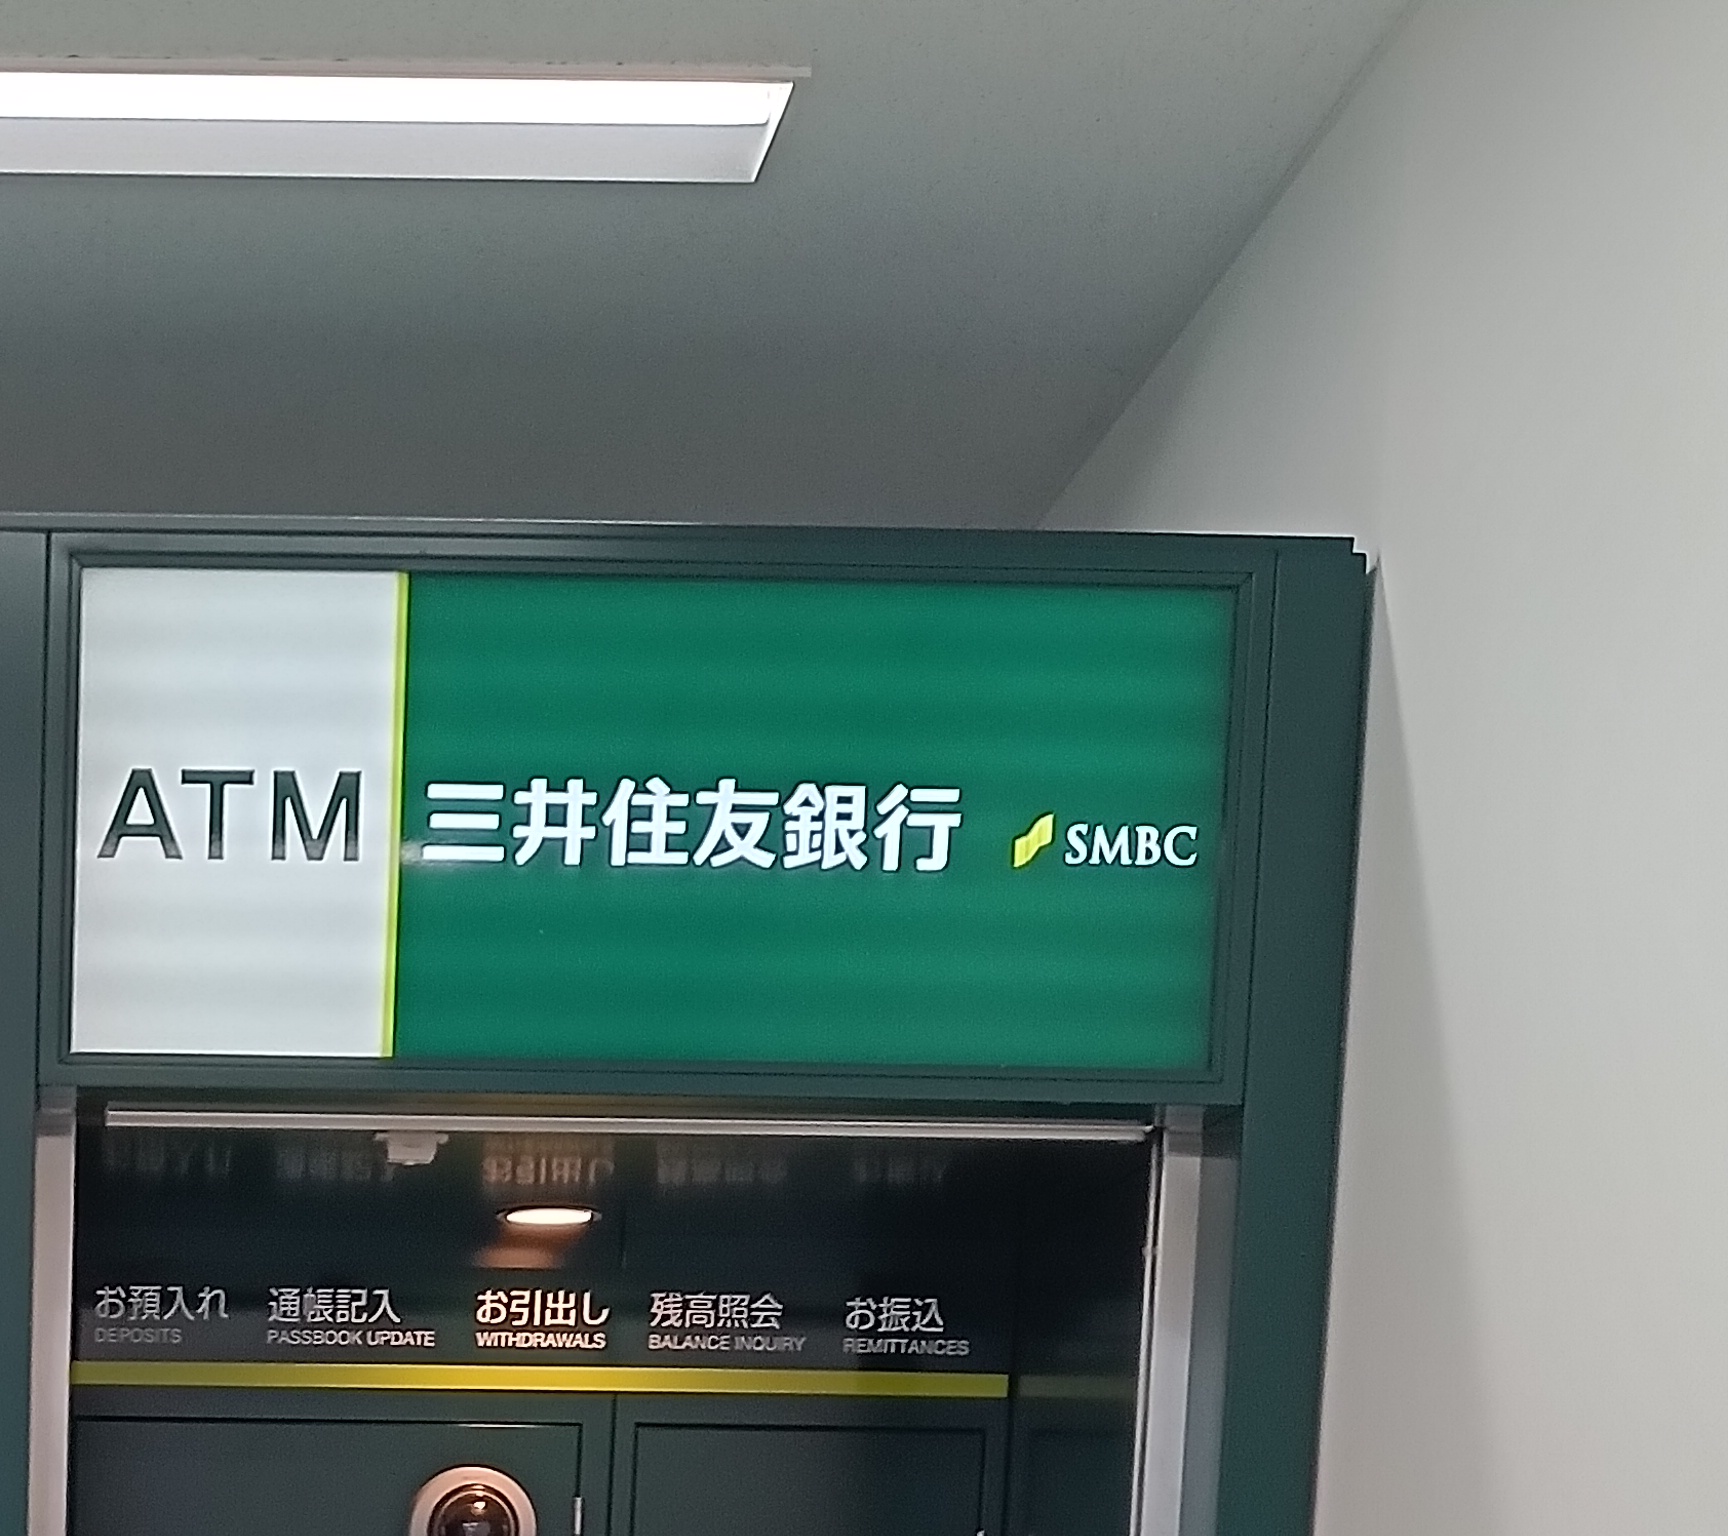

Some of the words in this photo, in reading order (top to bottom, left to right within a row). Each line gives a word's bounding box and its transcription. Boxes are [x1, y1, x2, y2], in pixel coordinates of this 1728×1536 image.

[97, 767, 365, 863] ATM
[421, 777, 962, 873] 三井住友銀行
[1064, 822, 1200, 869] SMBC
[94, 1285, 230, 1321] お預入れ
[267, 1287, 402, 1324] 通帳記入
[475, 1289, 610, 1327] お引出し
[649, 1291, 784, 1330] 残高照会
[844, 1296, 945, 1333] お振込
[94, 1327, 182, 1344] DEPOSITS
[267, 1328, 363, 1346] PASSBOOK
[367, 1330, 436, 1348] UPDATE
[475, 1331, 607, 1349] WITHDRAWALS
[648, 1333, 731, 1351] BALANCE
[734, 1336, 808, 1353] INQUIRY
[843, 1338, 970, 1357] REMITTANCES
